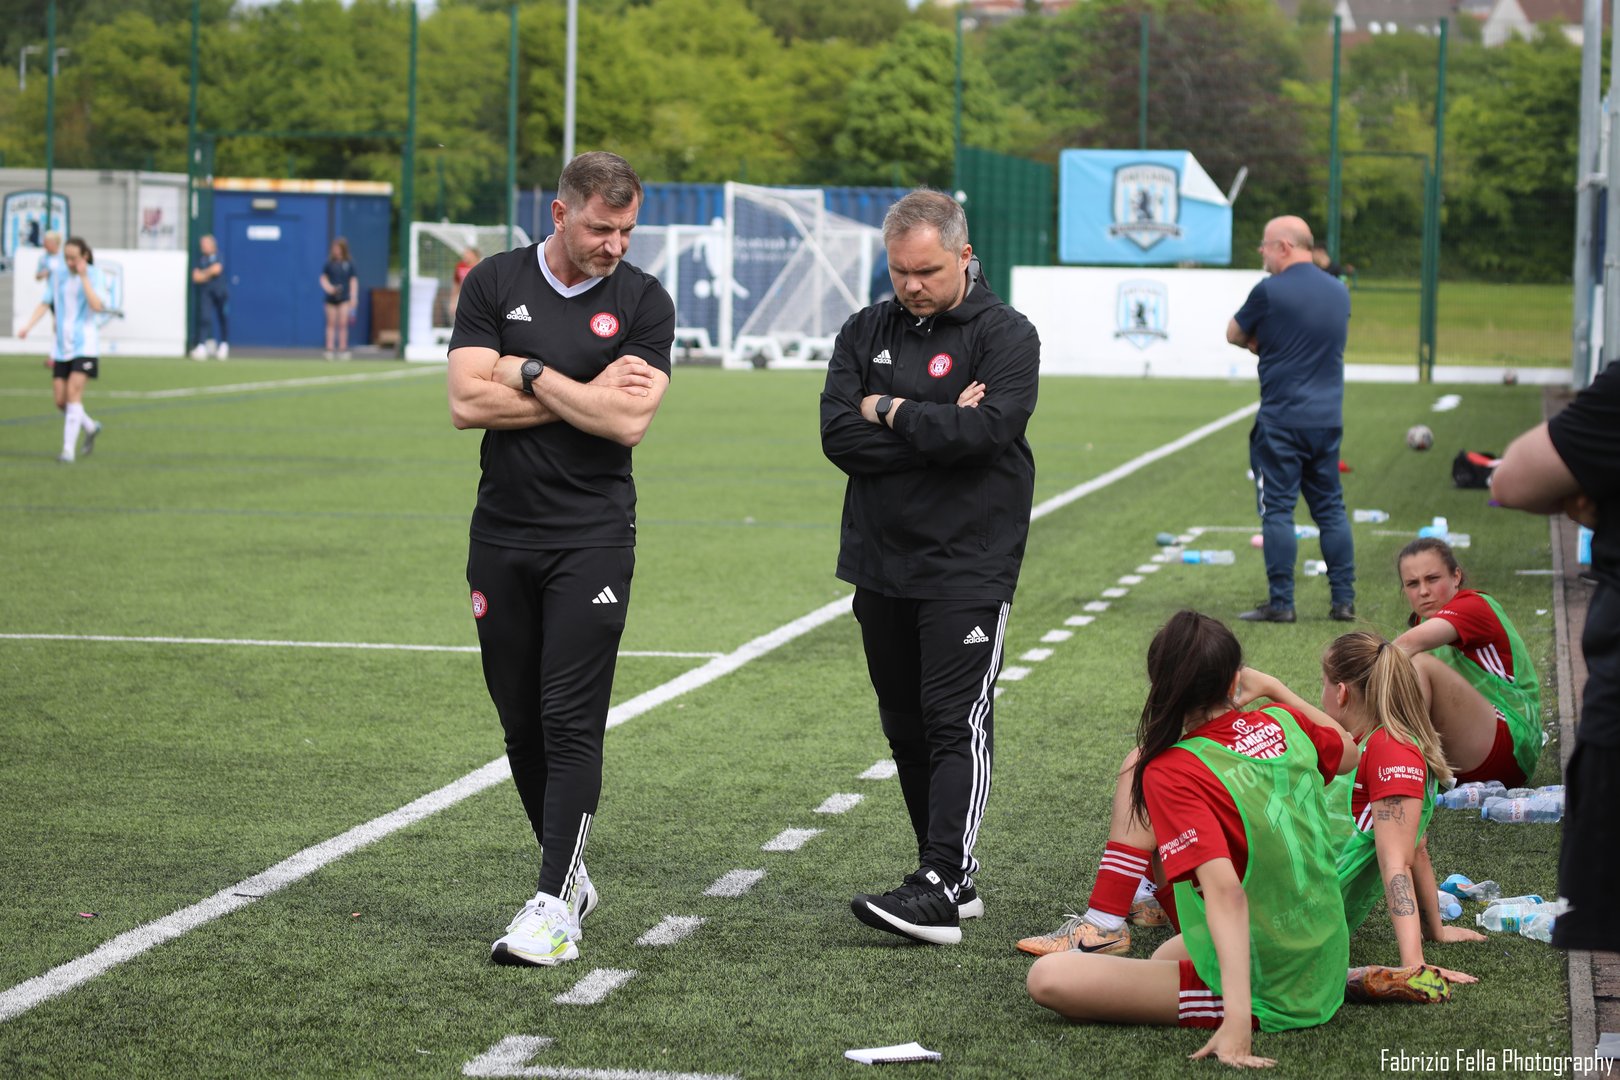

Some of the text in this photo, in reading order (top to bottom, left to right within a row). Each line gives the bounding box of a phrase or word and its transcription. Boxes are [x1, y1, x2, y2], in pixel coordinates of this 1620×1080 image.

[506, 313, 532, 322] adidas
[963, 635, 989, 645] adidas
[1382, 765, 1406, 775] LOMOND
